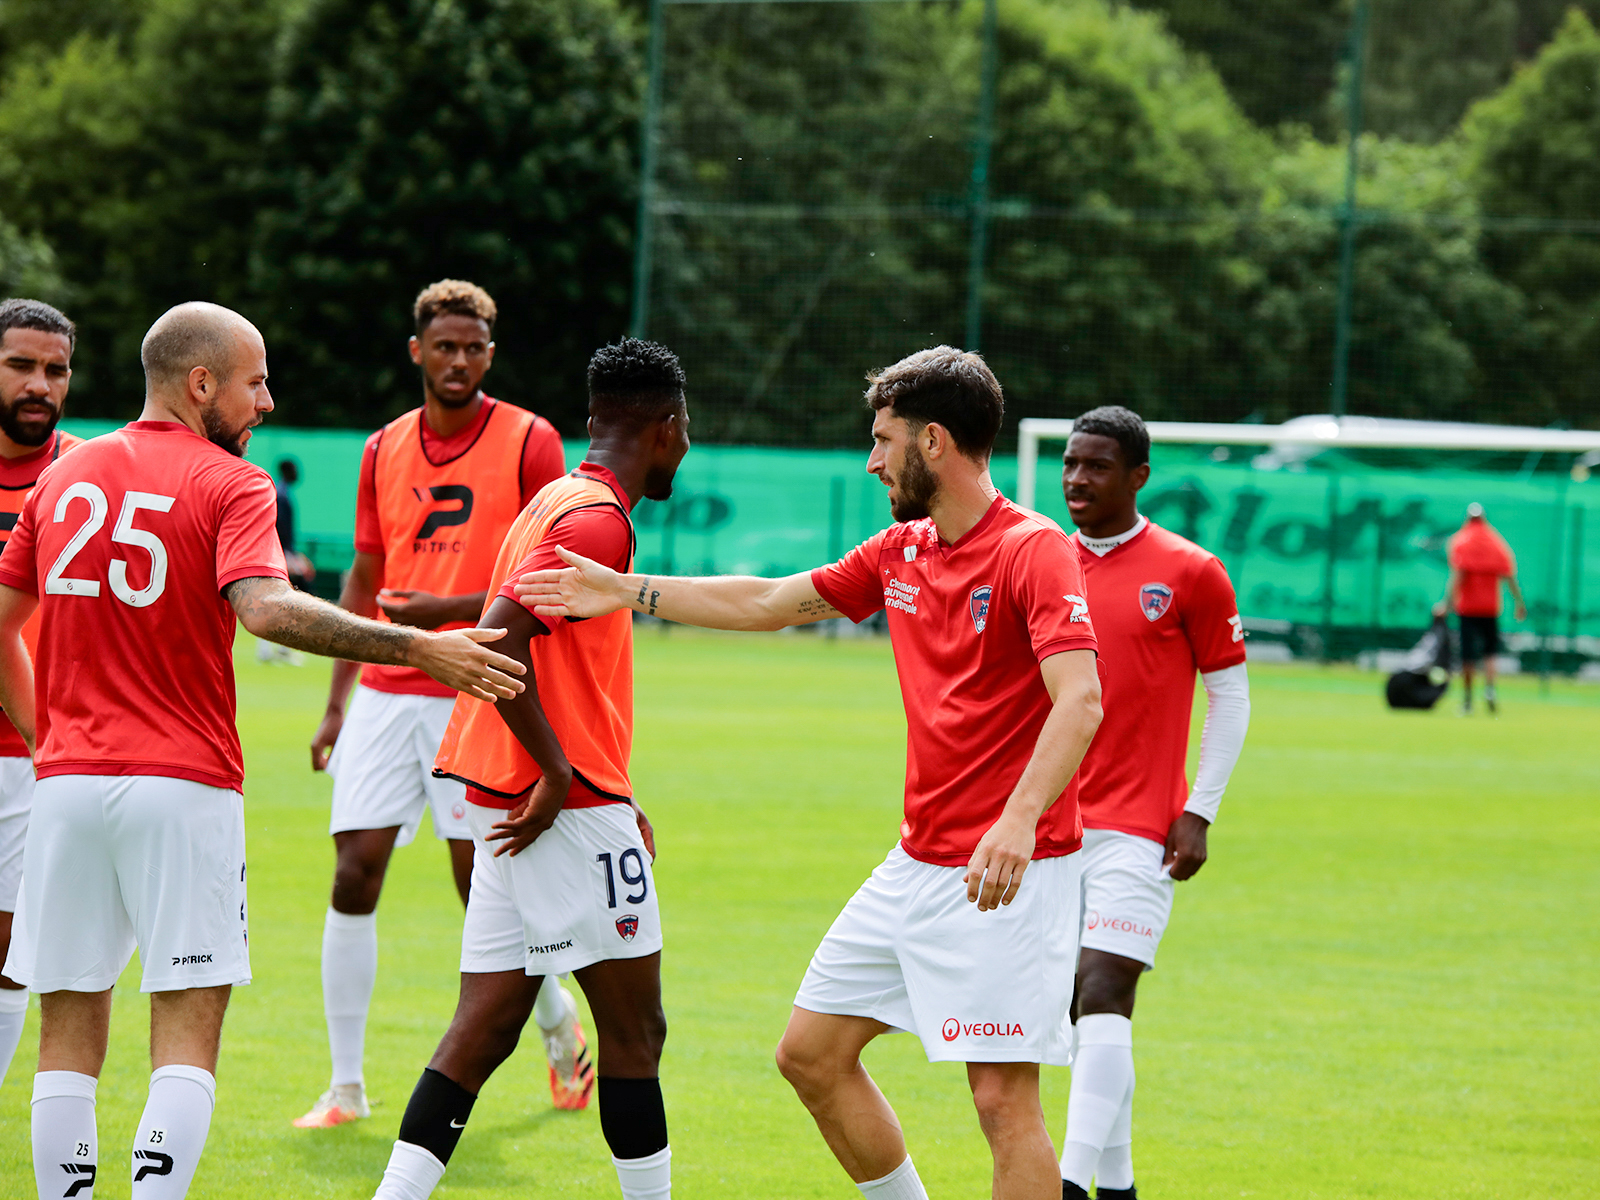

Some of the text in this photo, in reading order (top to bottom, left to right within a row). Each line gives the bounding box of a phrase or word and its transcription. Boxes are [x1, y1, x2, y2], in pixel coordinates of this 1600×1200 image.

[45, 481, 176, 608] 25
[596, 847, 647, 909] 19
[1101, 918, 1154, 939] VEOLIA
[534, 938, 574, 954] PATRICK
[182, 953, 213, 966] PTRICK
[963, 1022, 1024, 1037] VEOLIA
[150, 1130, 163, 1144] 25
[76, 1142, 89, 1157] 25
